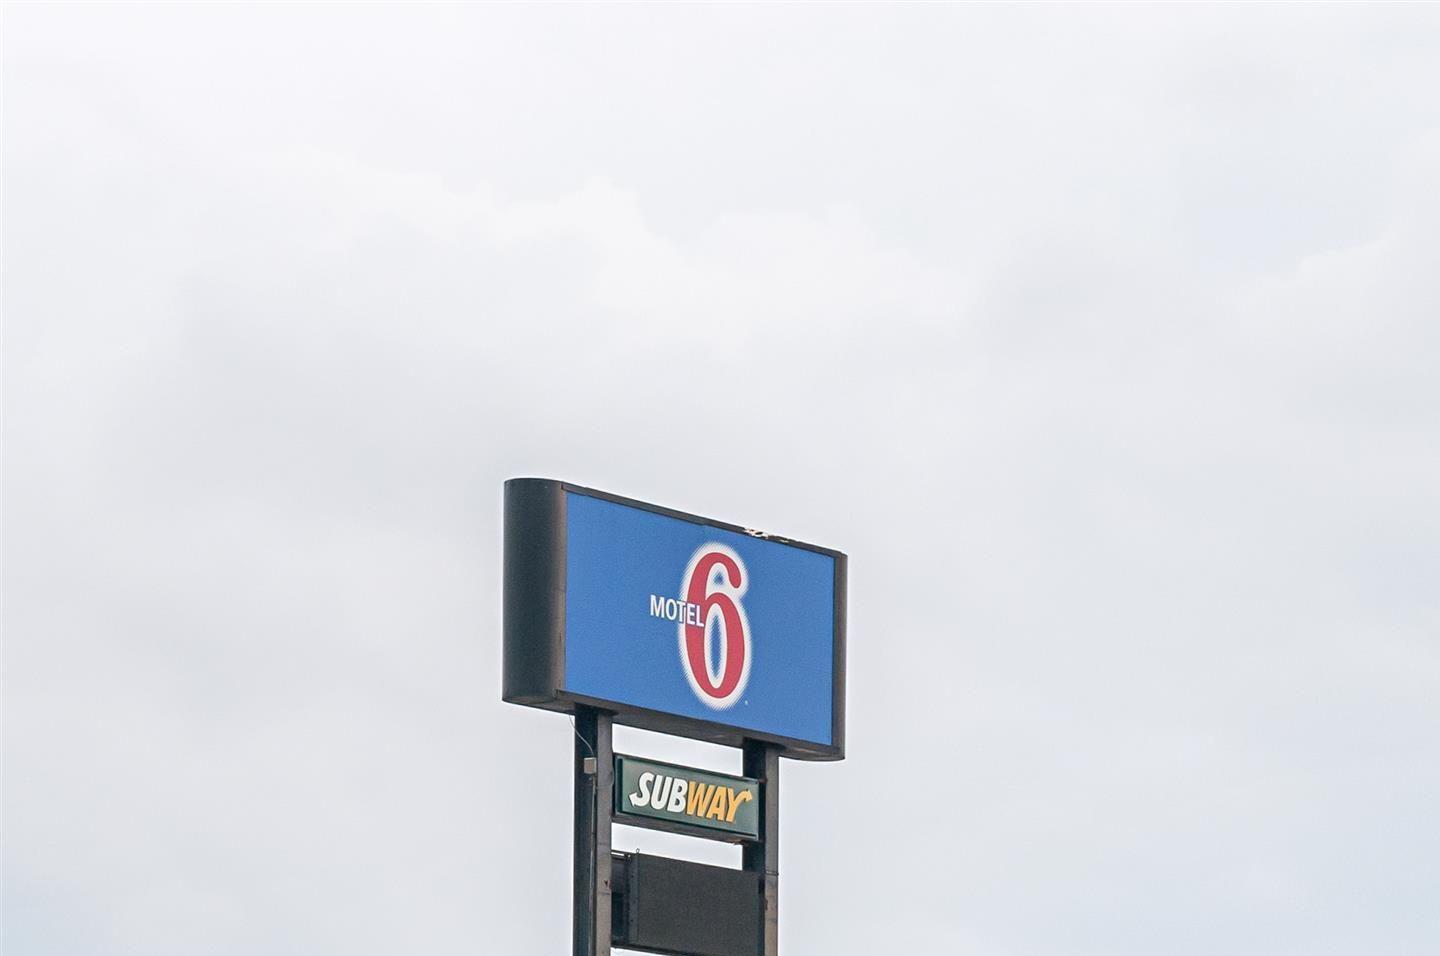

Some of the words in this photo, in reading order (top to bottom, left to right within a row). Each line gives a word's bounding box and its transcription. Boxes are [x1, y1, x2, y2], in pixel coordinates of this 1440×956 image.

[650, 594, 704, 627] MOTEL
[682, 547, 748, 705] 6
[629, 772, 753, 822] SUBWAY
